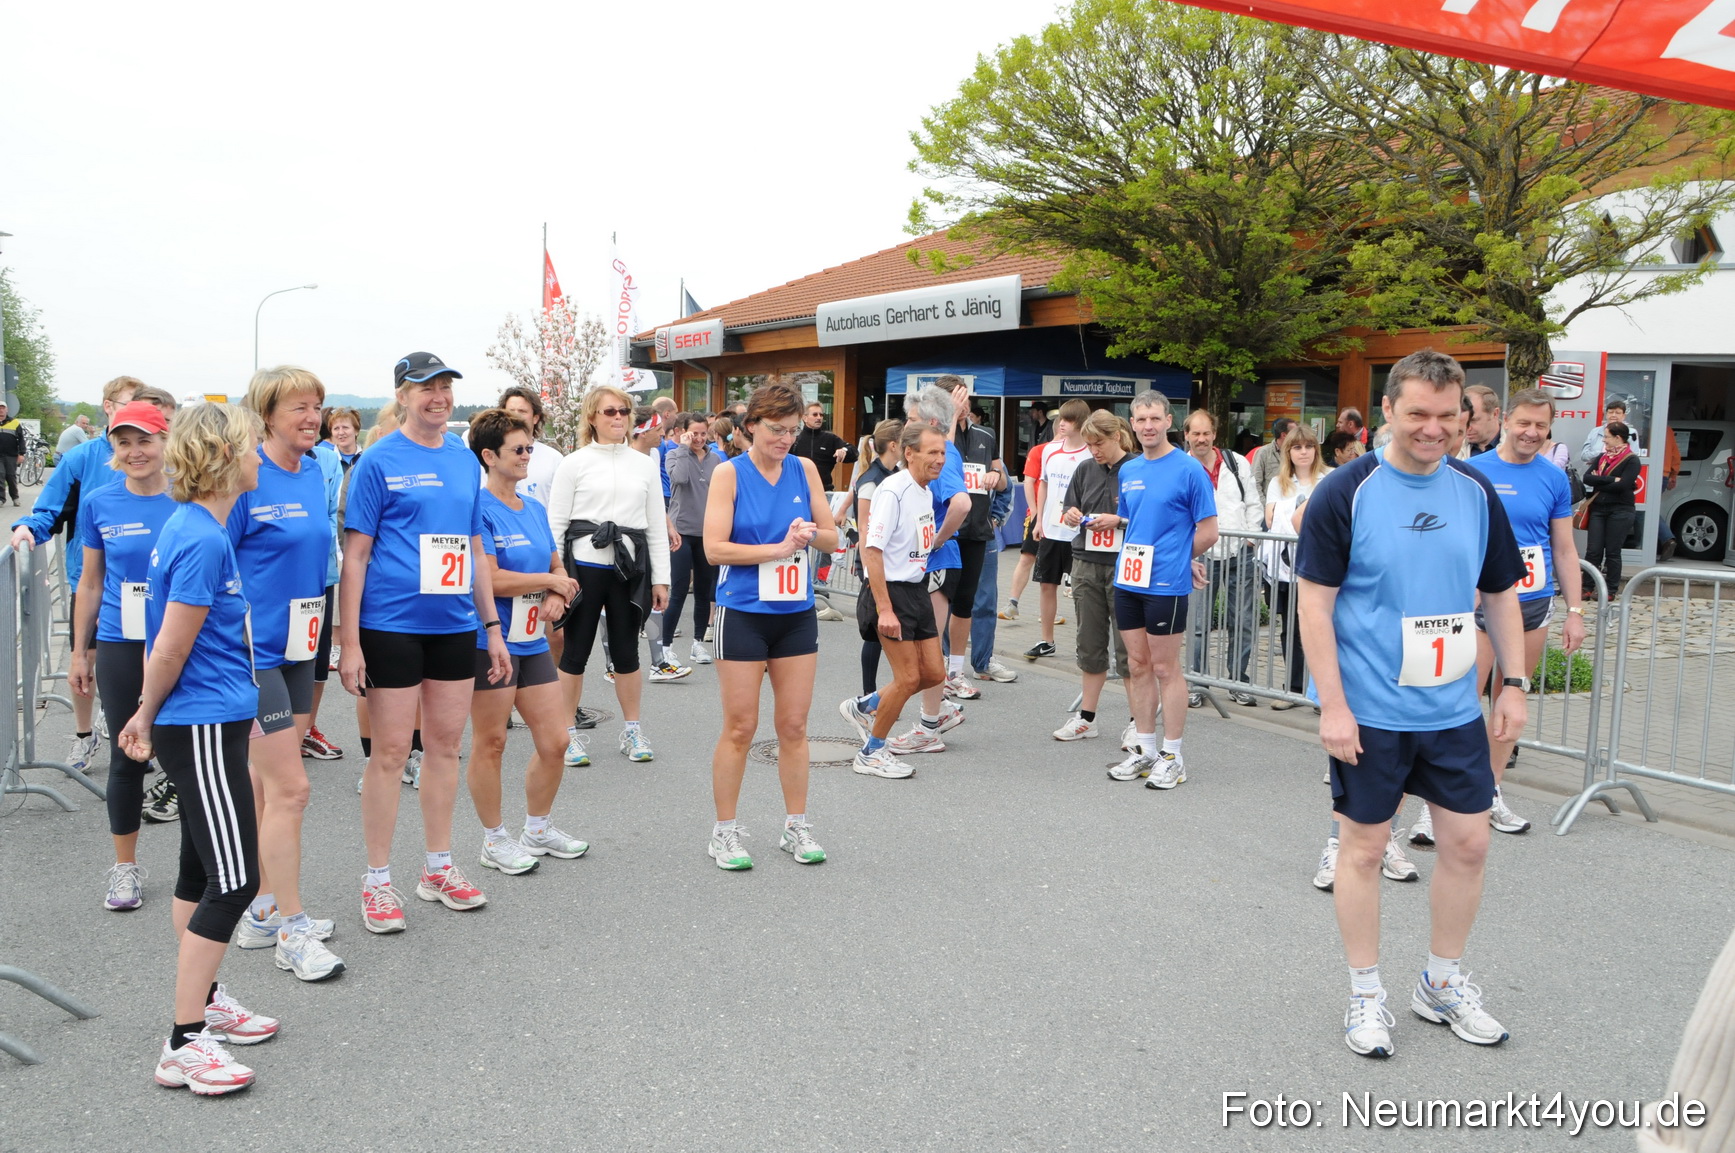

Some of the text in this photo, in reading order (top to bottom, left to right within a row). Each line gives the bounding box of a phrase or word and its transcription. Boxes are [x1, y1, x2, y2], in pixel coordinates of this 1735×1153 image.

[825, 295, 1002, 333] Autohaus Gerhart & Jänig
[674, 331, 712, 349] SEAT
[1063, 381, 1132, 394] Neumarkter Tagblatt
[964, 471, 979, 490] 91
[431, 537, 459, 545] MEYER
[1092, 528, 1114, 548] 89
[441, 552, 465, 587] 21
[1123, 557, 1143, 583] 68
[775, 564, 799, 595] 10
[300, 600, 322, 610] MEYER
[522, 592, 542, 600] MEYER
[525, 605, 539, 635] 8
[1414, 618, 1449, 629] MEYER
[308, 616, 319, 653] 9
[1414, 627, 1450, 636] WERBUNG
[1431, 637, 1444, 677] 1
[263, 709, 290, 723] ODLO
